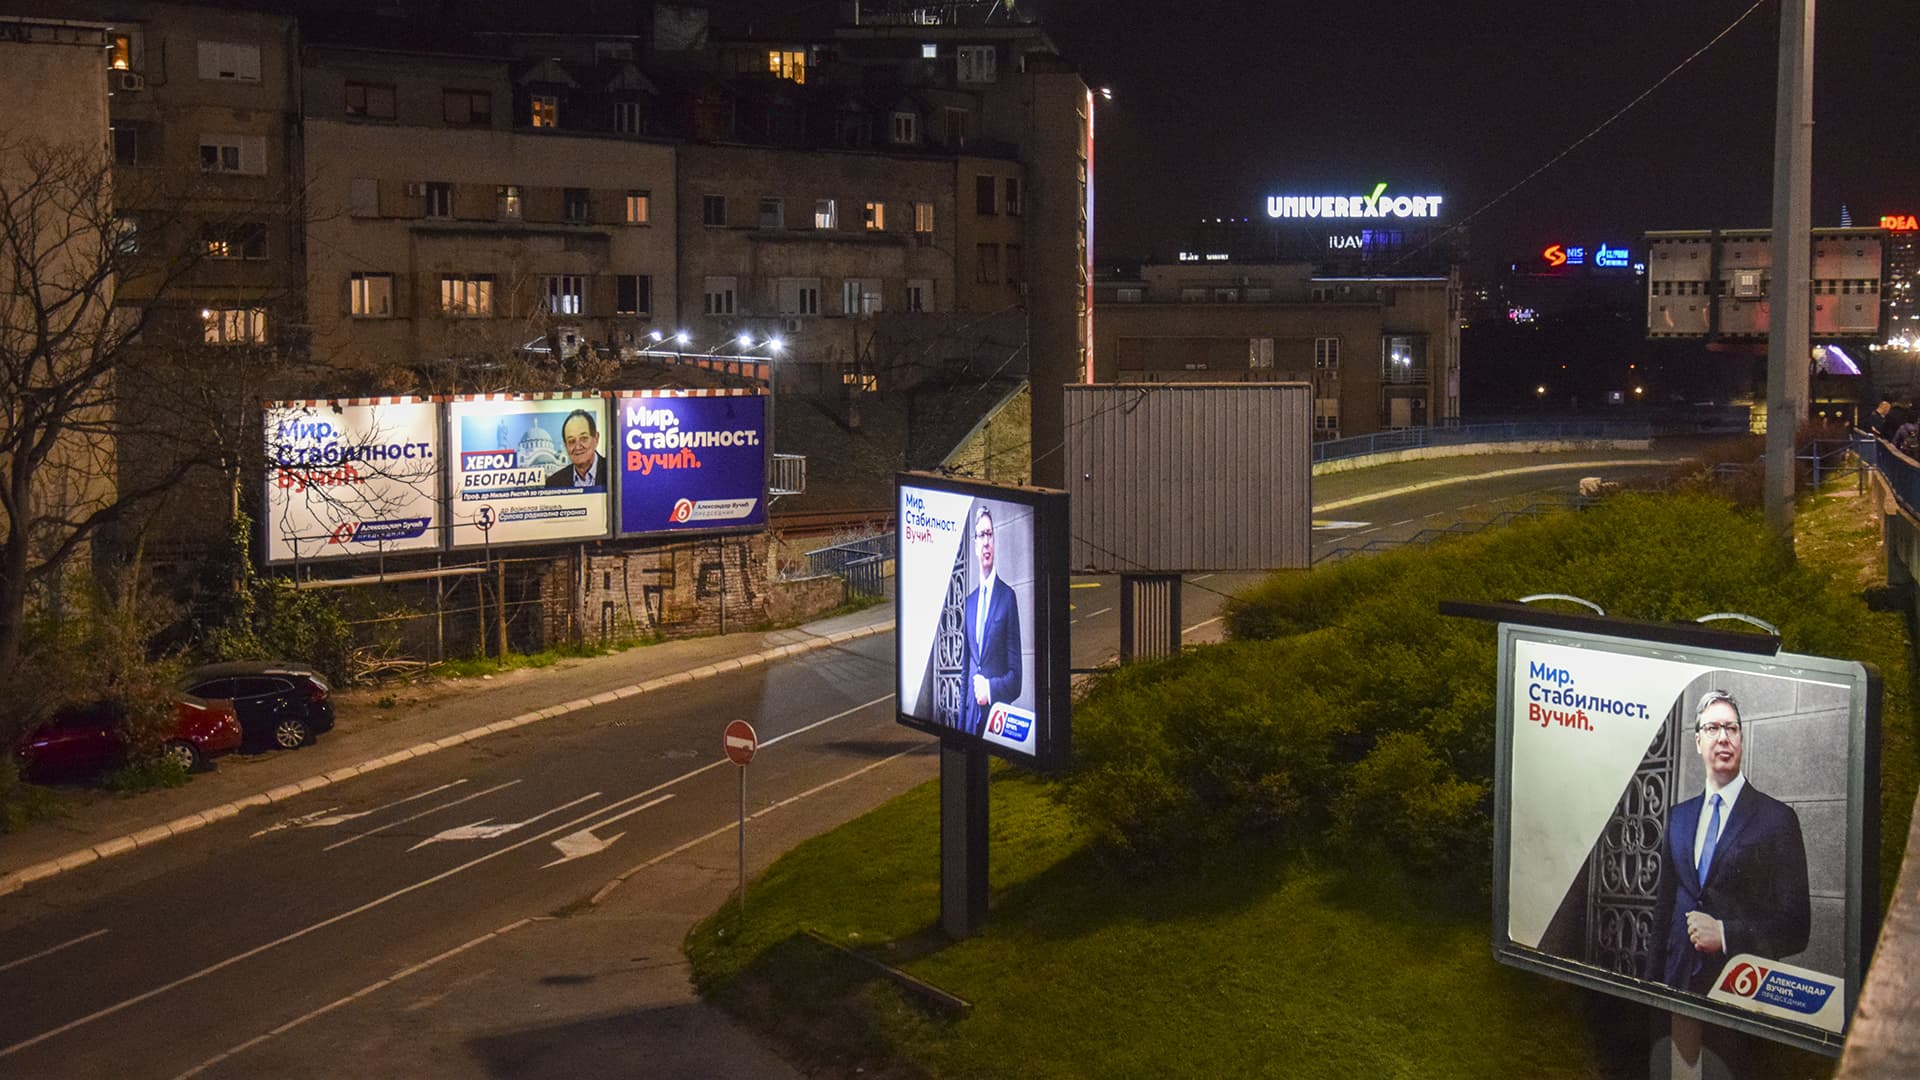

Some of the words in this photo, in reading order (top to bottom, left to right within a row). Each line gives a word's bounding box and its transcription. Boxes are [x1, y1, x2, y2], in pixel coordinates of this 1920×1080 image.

[1267, 184, 1442, 217] UNIVEREXPORT
[1566, 248, 1583, 257] NIS
[626, 406, 679, 431] Мир.
[278, 419, 338, 443] Мир.
[626, 427, 759, 450] Стабилност.
[277, 441, 433, 465] Стабилност.
[466, 454, 514, 470] ХЕРОЈ
[627, 447, 702, 476] Вучић.
[278, 462, 366, 493] Вучић.
[465, 471, 542, 487] БЕОГРАДА!
[678, 503, 688, 519] 6
[906, 493, 925, 512] Мир.
[479, 508, 491, 527] 3
[906, 510, 957, 532] Стабилност.
[906, 526, 934, 544] Вучић.
[1529, 661, 1575, 688] Мир.
[1529, 683, 1650, 720] Стабилност.
[994, 711, 1002, 734] 6
[1529, 702, 1594, 732] Вучић.
[1734, 966, 1754, 995] 6
[1765, 983, 1794, 998] ВУЧИЋ
[1769, 976, 1826, 996] АЛЕКСАНДАР
